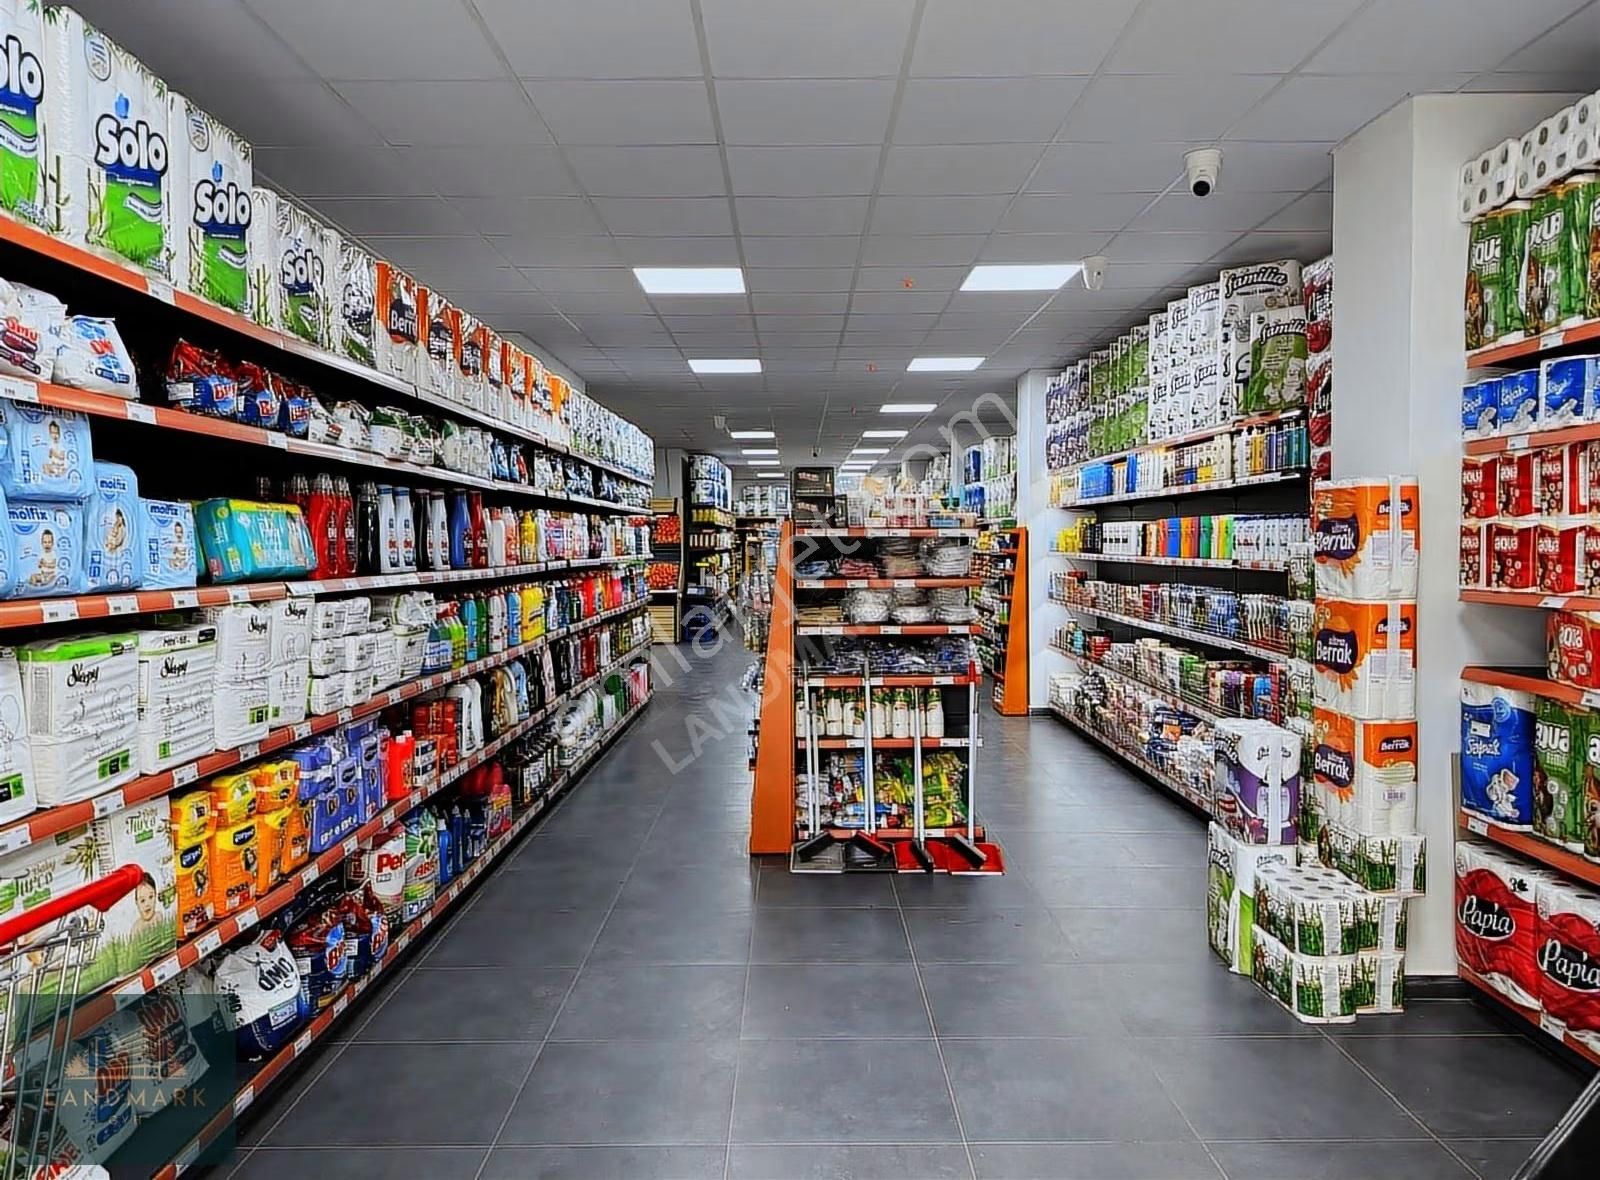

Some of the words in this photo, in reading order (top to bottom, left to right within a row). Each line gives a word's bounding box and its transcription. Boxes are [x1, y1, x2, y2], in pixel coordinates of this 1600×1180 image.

[94, 114, 168, 178] Solo
[193, 179, 252, 231] Solo
[281, 249, 325, 290] Solo
[8, 506, 48, 521] molfix
[1316, 640, 1352, 665] Berrak
[1314, 751, 1350, 781] Berrak
[1463, 894, 1511, 935] Papia
[258, 957, 294, 991] OMO
